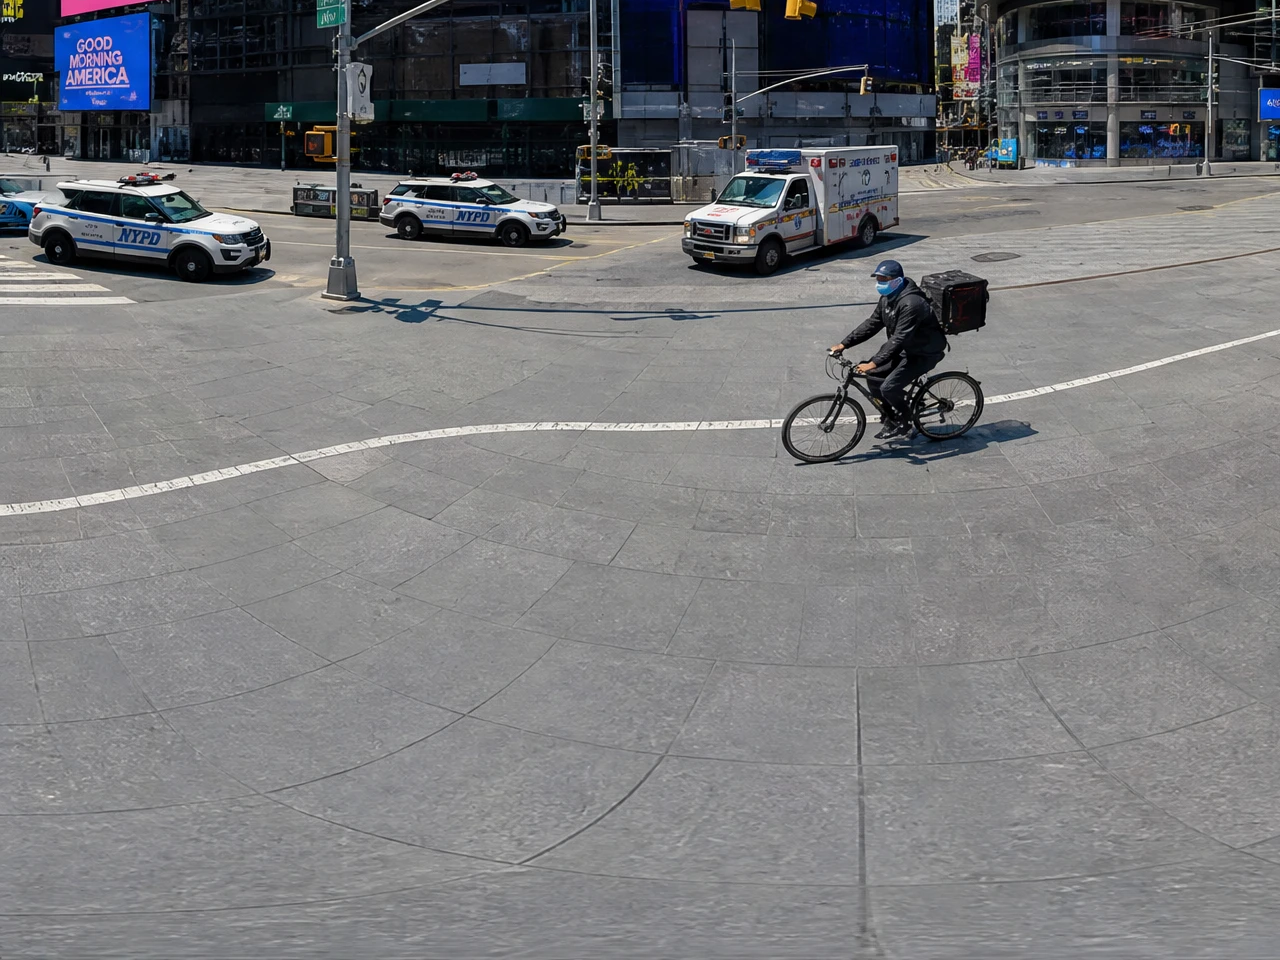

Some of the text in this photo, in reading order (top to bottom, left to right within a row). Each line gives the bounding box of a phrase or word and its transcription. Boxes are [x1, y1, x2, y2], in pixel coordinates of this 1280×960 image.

[76, 36, 113, 53] GOOD
[69, 50, 123, 69] MORNING
[65, 66, 130, 86] AMERICA
[455, 210, 491, 222] NYPD
[117, 228, 161, 246] NYPD
